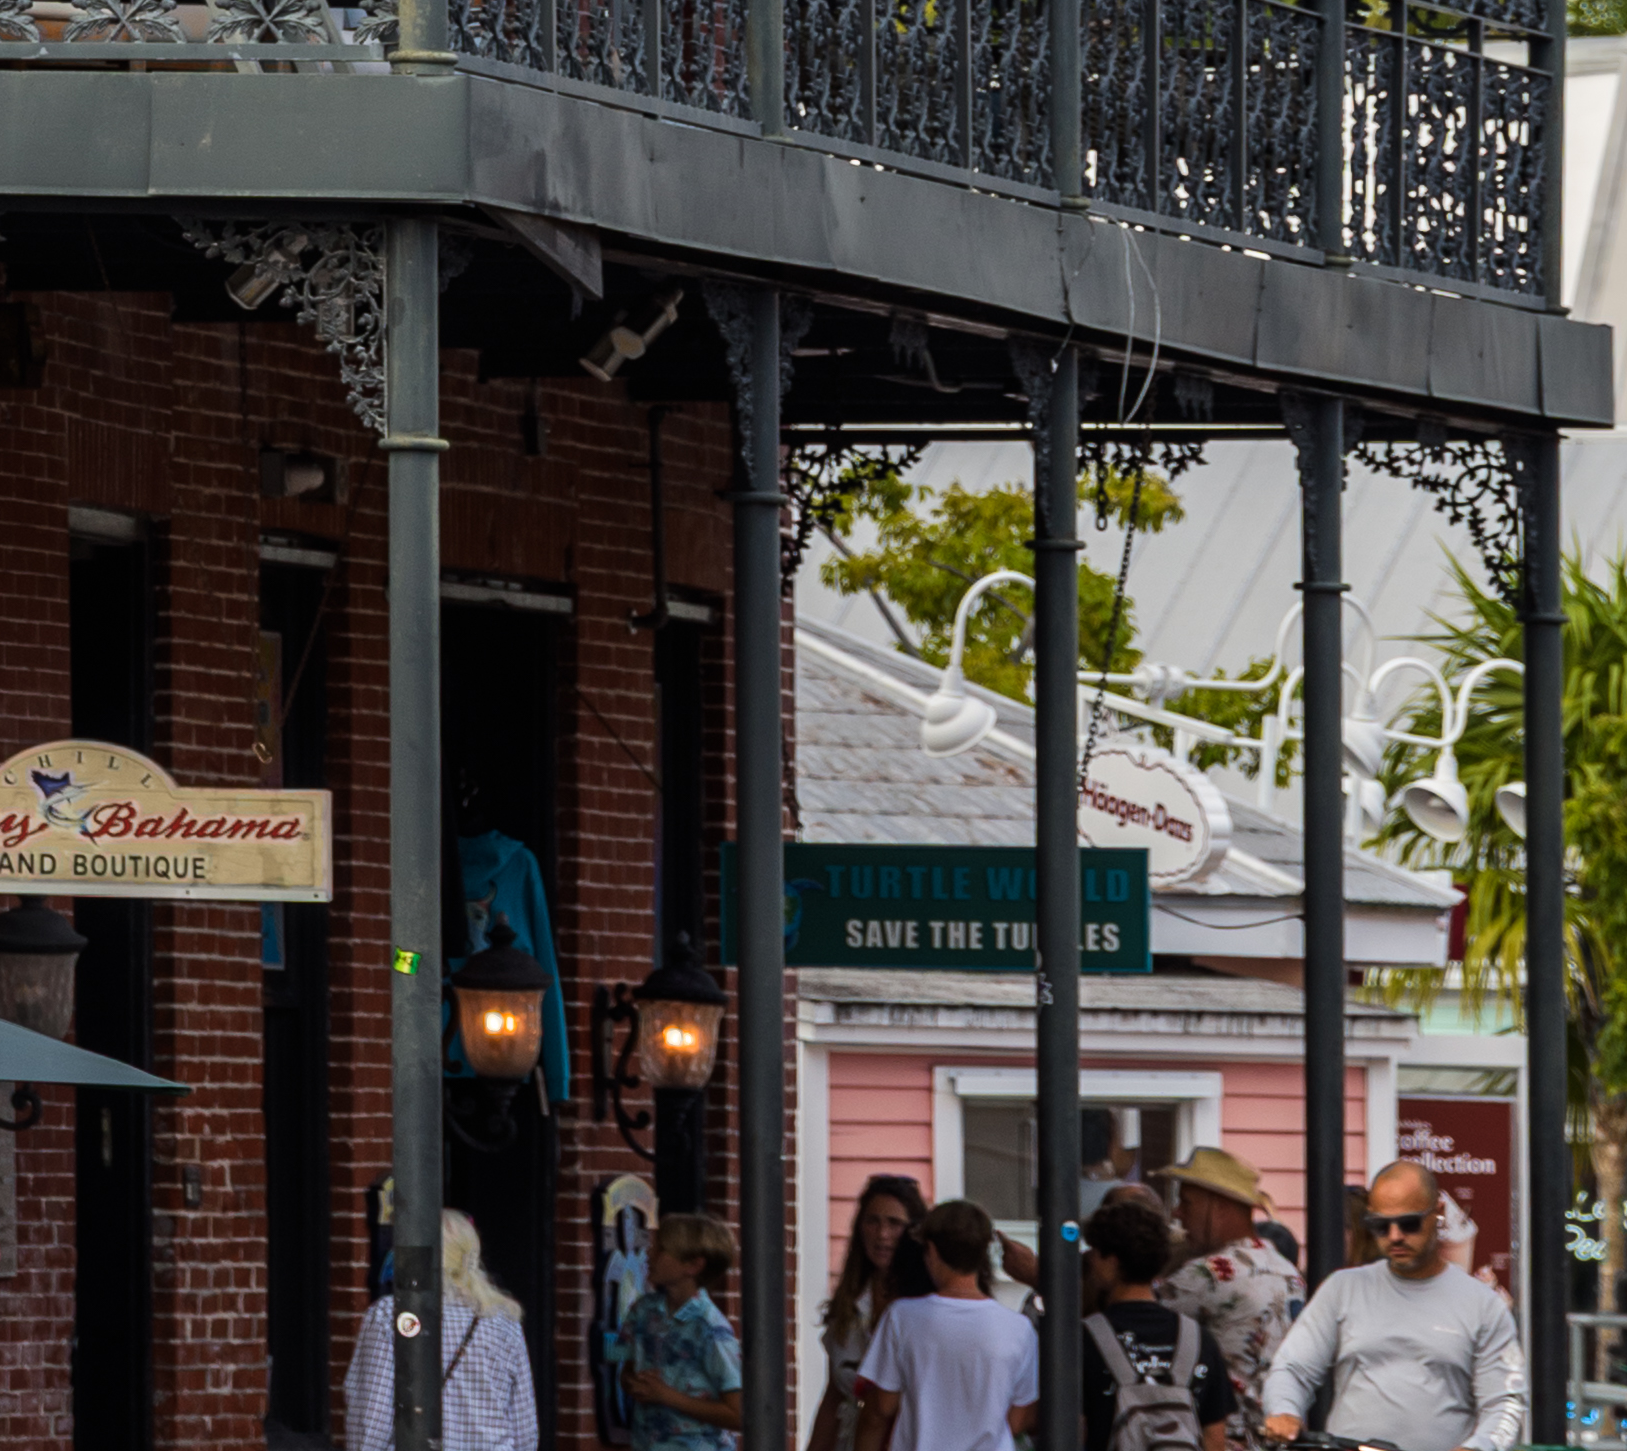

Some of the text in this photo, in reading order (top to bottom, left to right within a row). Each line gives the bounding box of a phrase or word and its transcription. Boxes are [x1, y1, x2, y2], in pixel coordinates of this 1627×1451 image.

[82, 800, 303, 844] Bahama
[73, 854, 206, 880] BOUTIQUE
[824, 864, 1130, 903] TURTLE WLD
[845, 918, 1121, 953] SAVE THE TUES
[1396, 1130, 1455, 1152] offee
